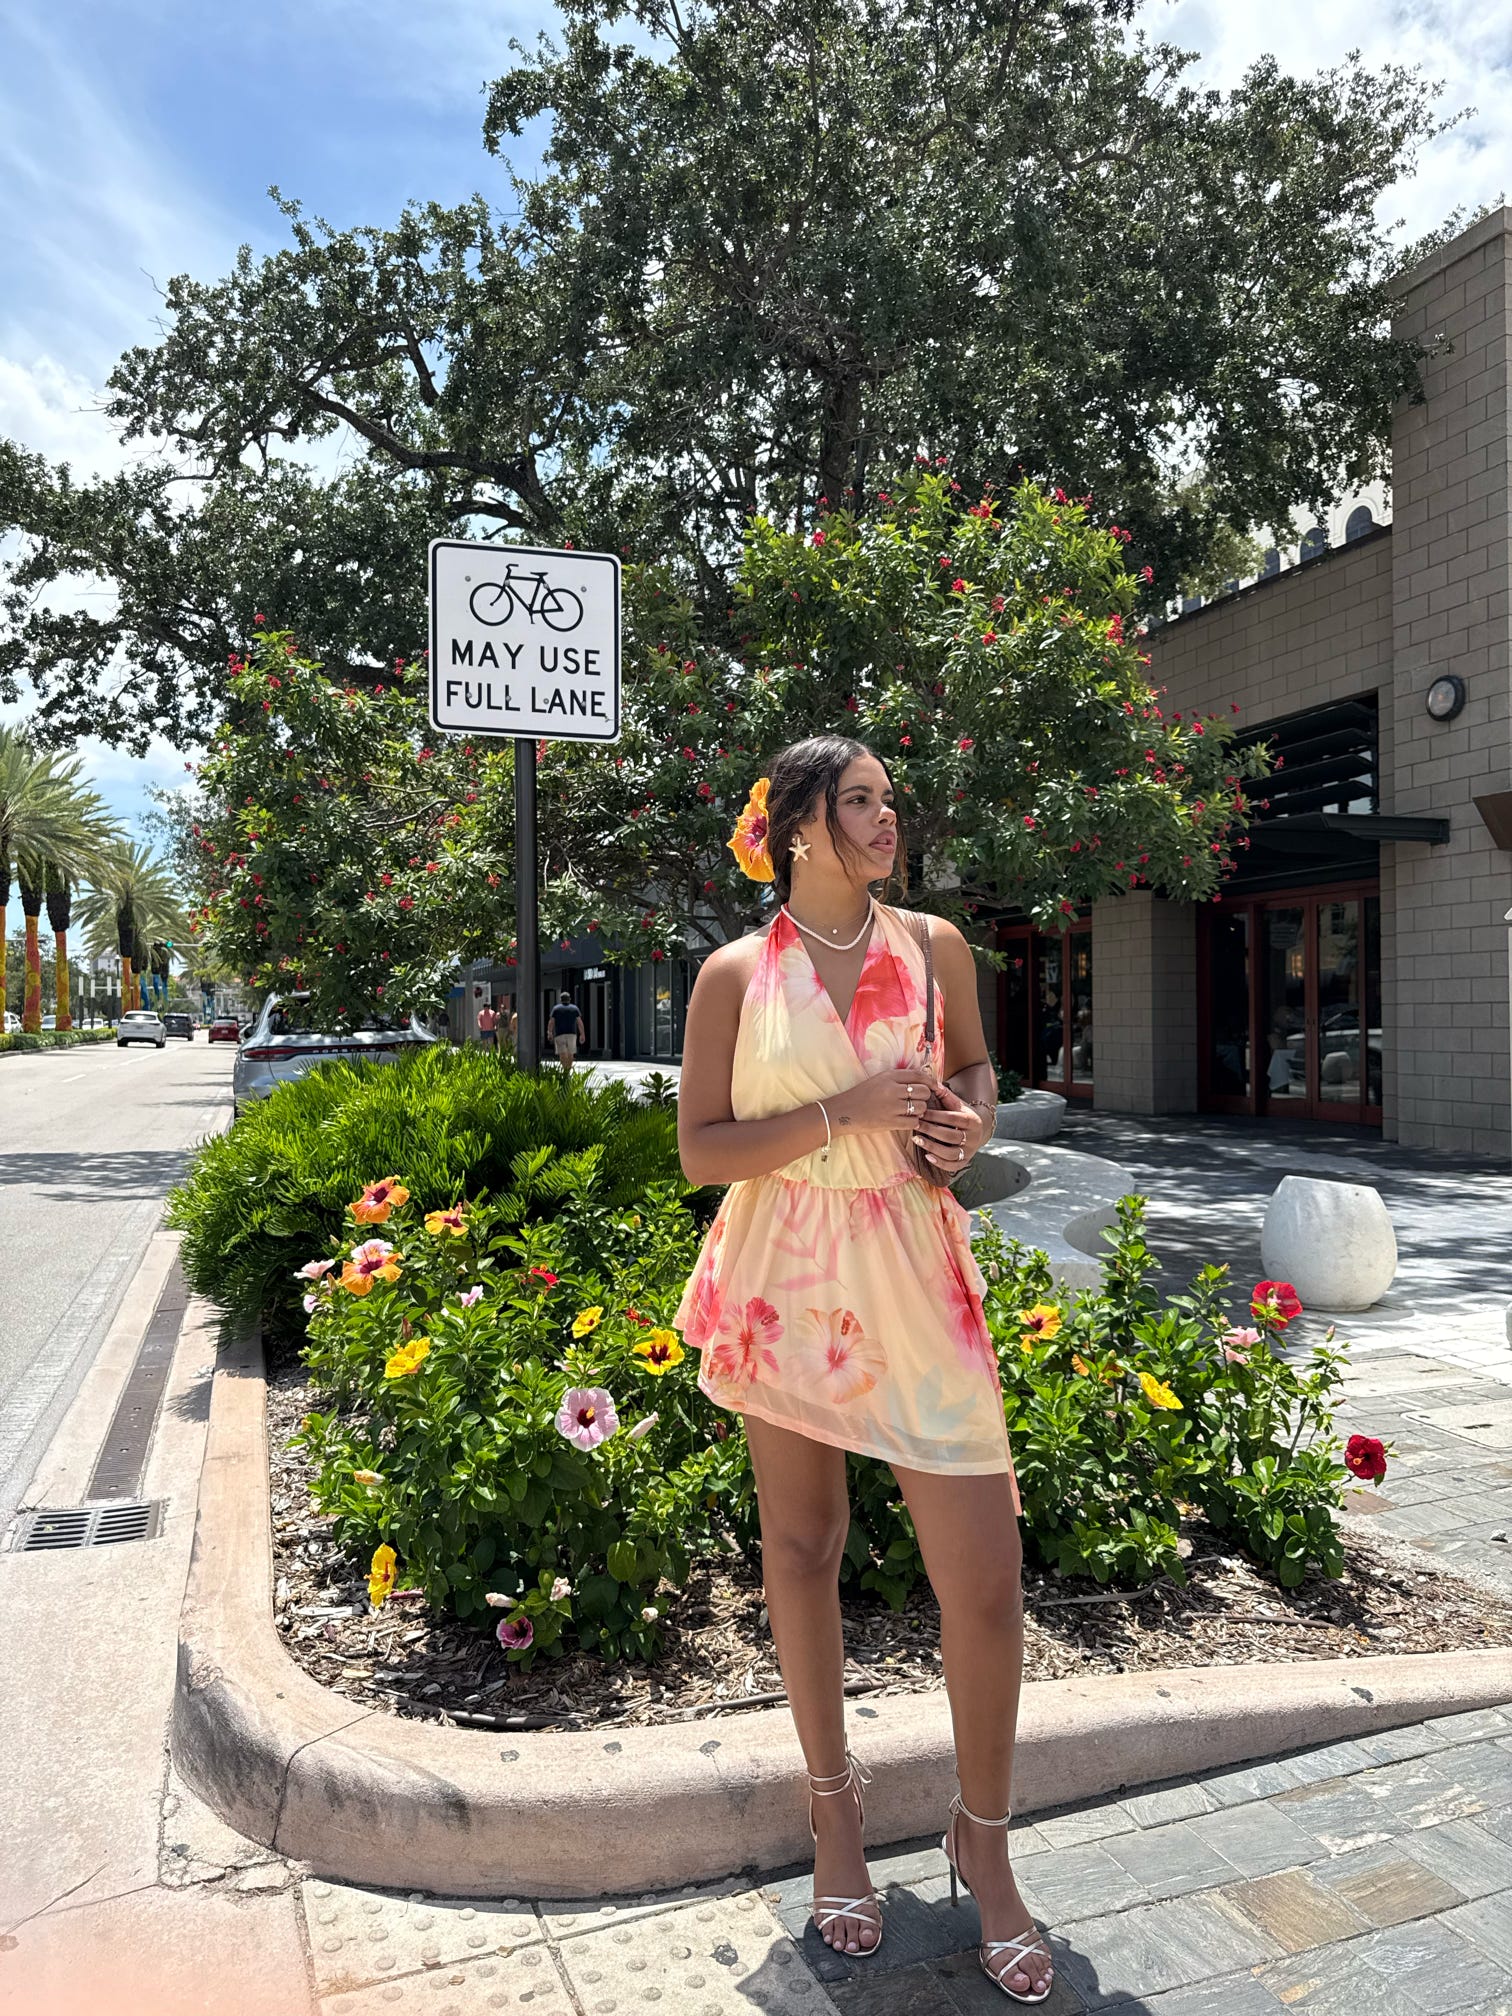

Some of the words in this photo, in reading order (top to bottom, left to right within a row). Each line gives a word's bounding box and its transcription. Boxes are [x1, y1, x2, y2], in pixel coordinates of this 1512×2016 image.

[452, 639, 524, 670] MAY
[540, 646, 601, 676] USE
[446, 680, 520, 712] FULL
[531, 687, 606, 717] LANE
